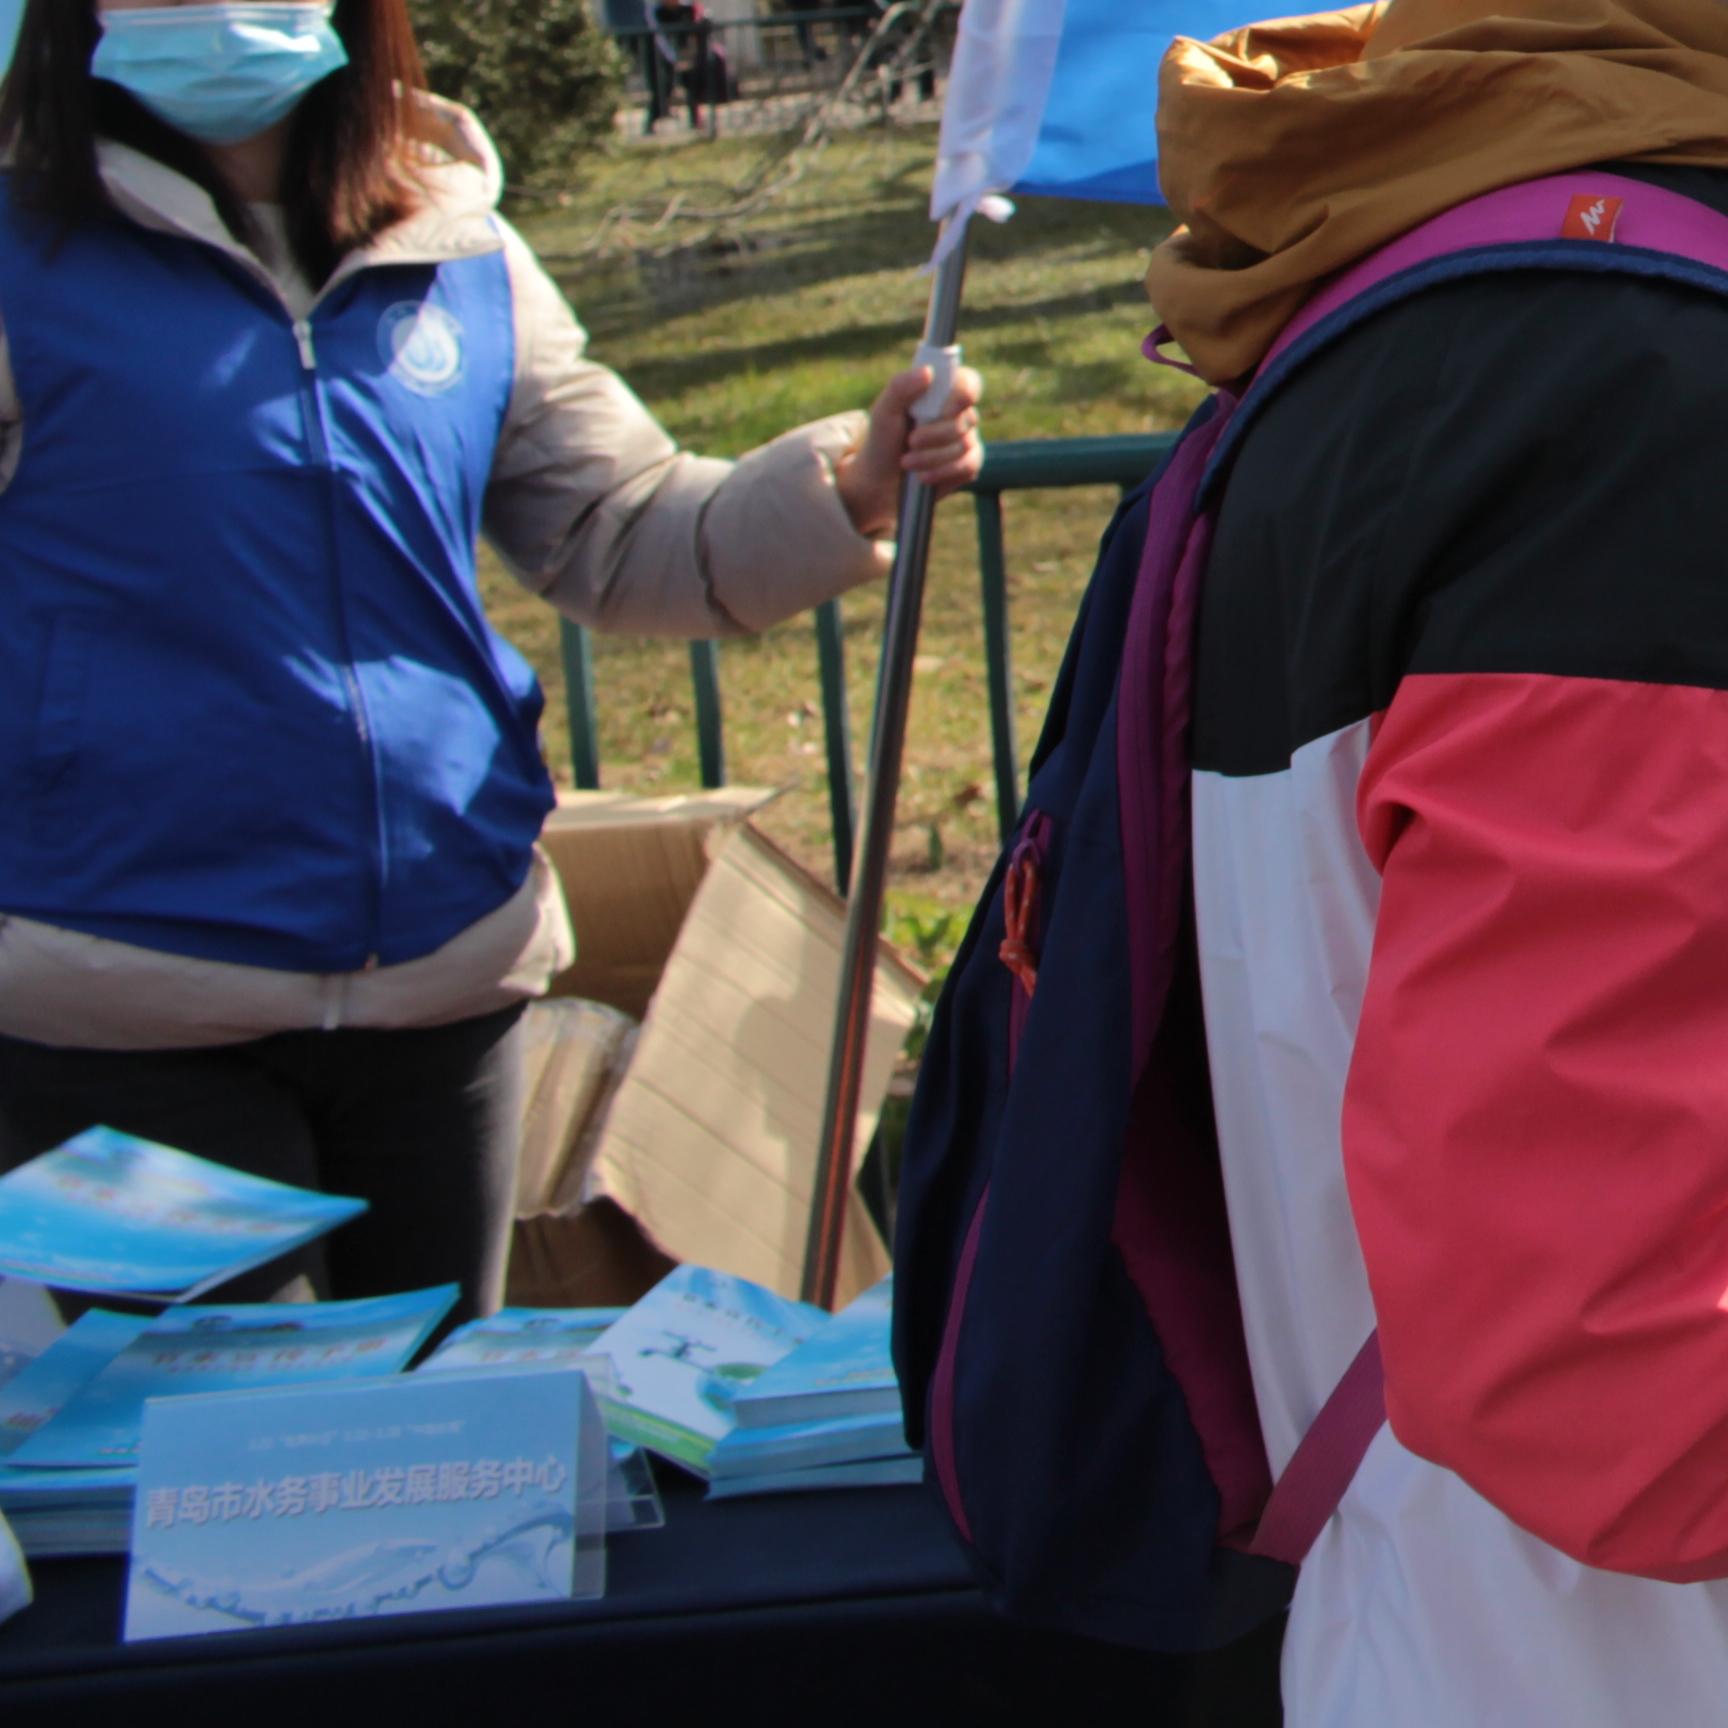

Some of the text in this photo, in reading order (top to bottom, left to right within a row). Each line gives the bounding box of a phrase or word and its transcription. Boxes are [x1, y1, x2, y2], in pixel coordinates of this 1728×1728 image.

[145, 1453, 568, 1529] 青岛市水务事业发展服务中心
